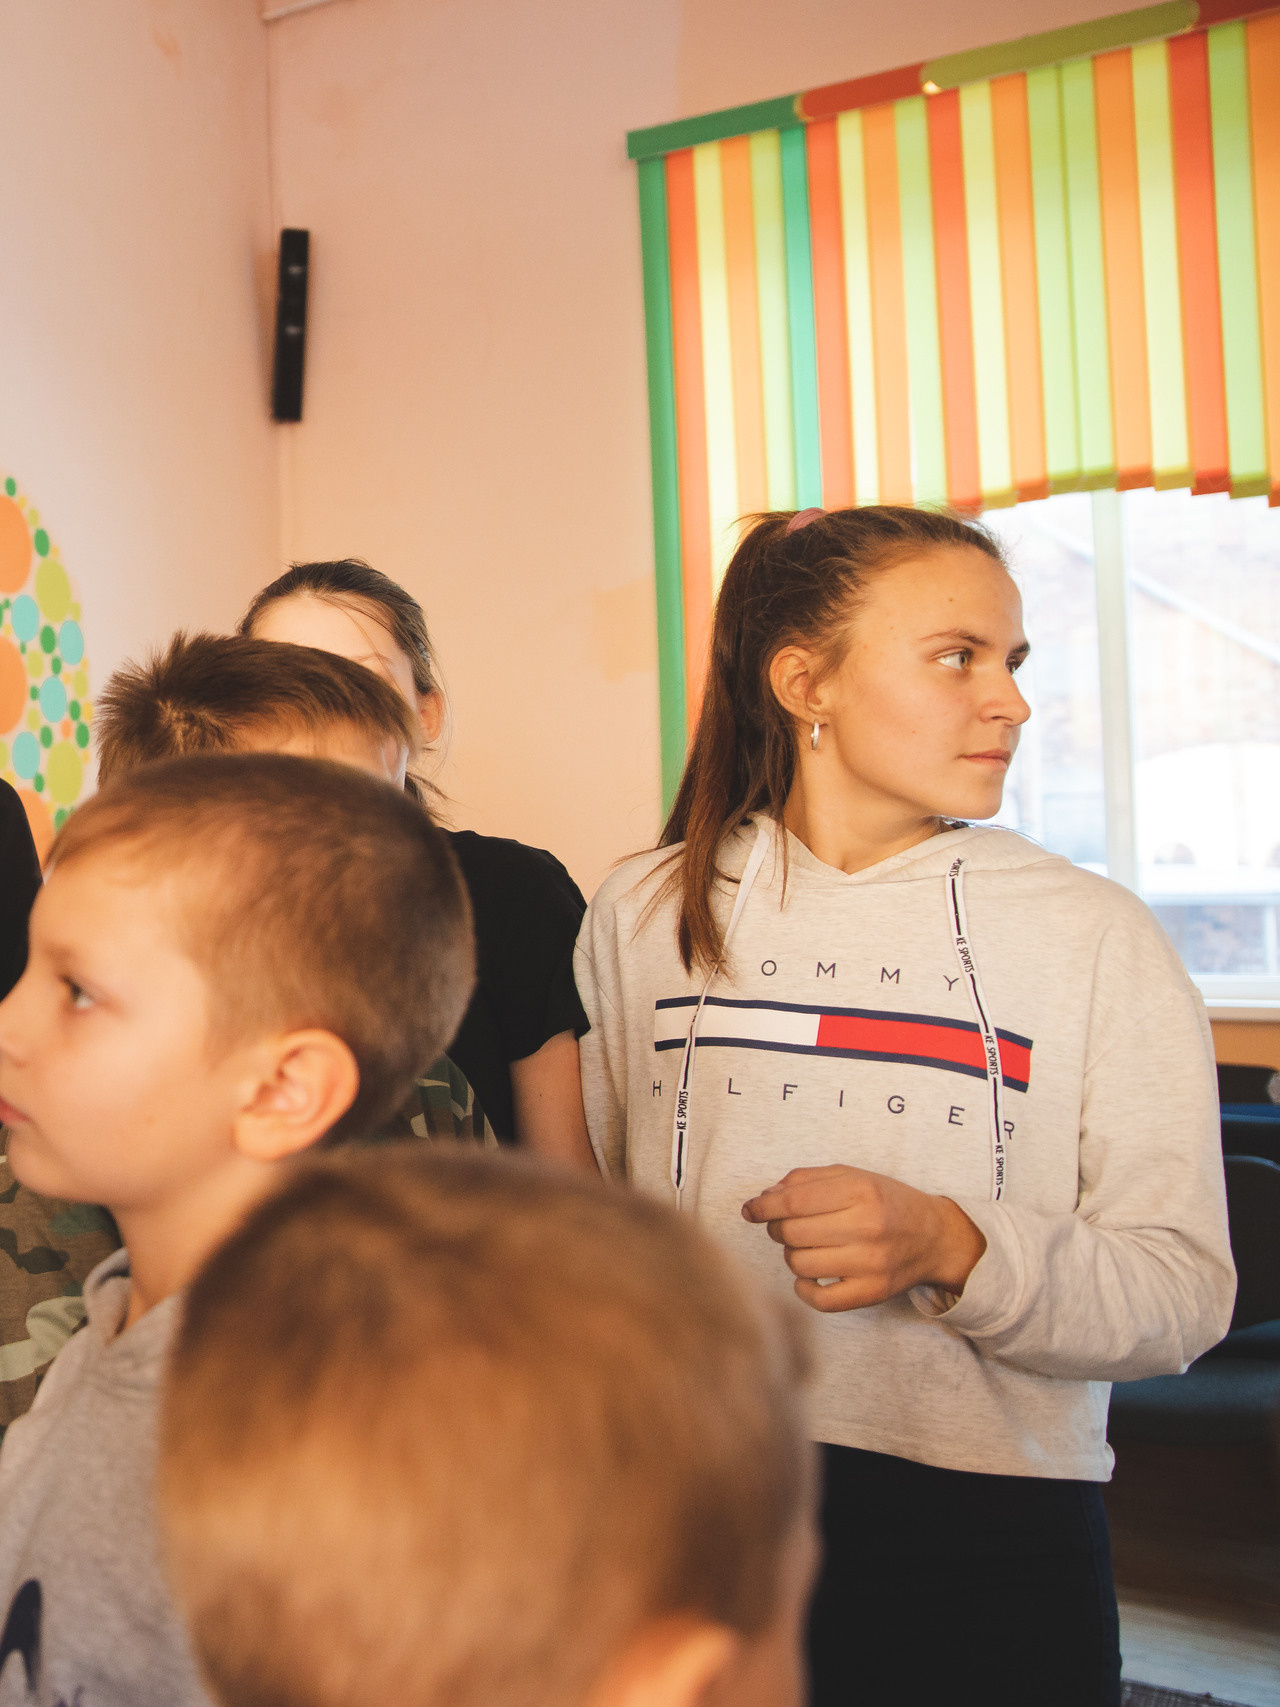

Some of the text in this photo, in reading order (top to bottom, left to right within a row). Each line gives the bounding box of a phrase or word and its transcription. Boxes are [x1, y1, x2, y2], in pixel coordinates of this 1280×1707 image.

[958, 947, 975, 973] SPORTS
[986, 1047, 999, 1075] SPORTS
[652, 1078, 1015, 1140] HLFIGER
[677, 1090, 689, 1118] SPORTS
[995, 1157, 1004, 1186] SPORTS
